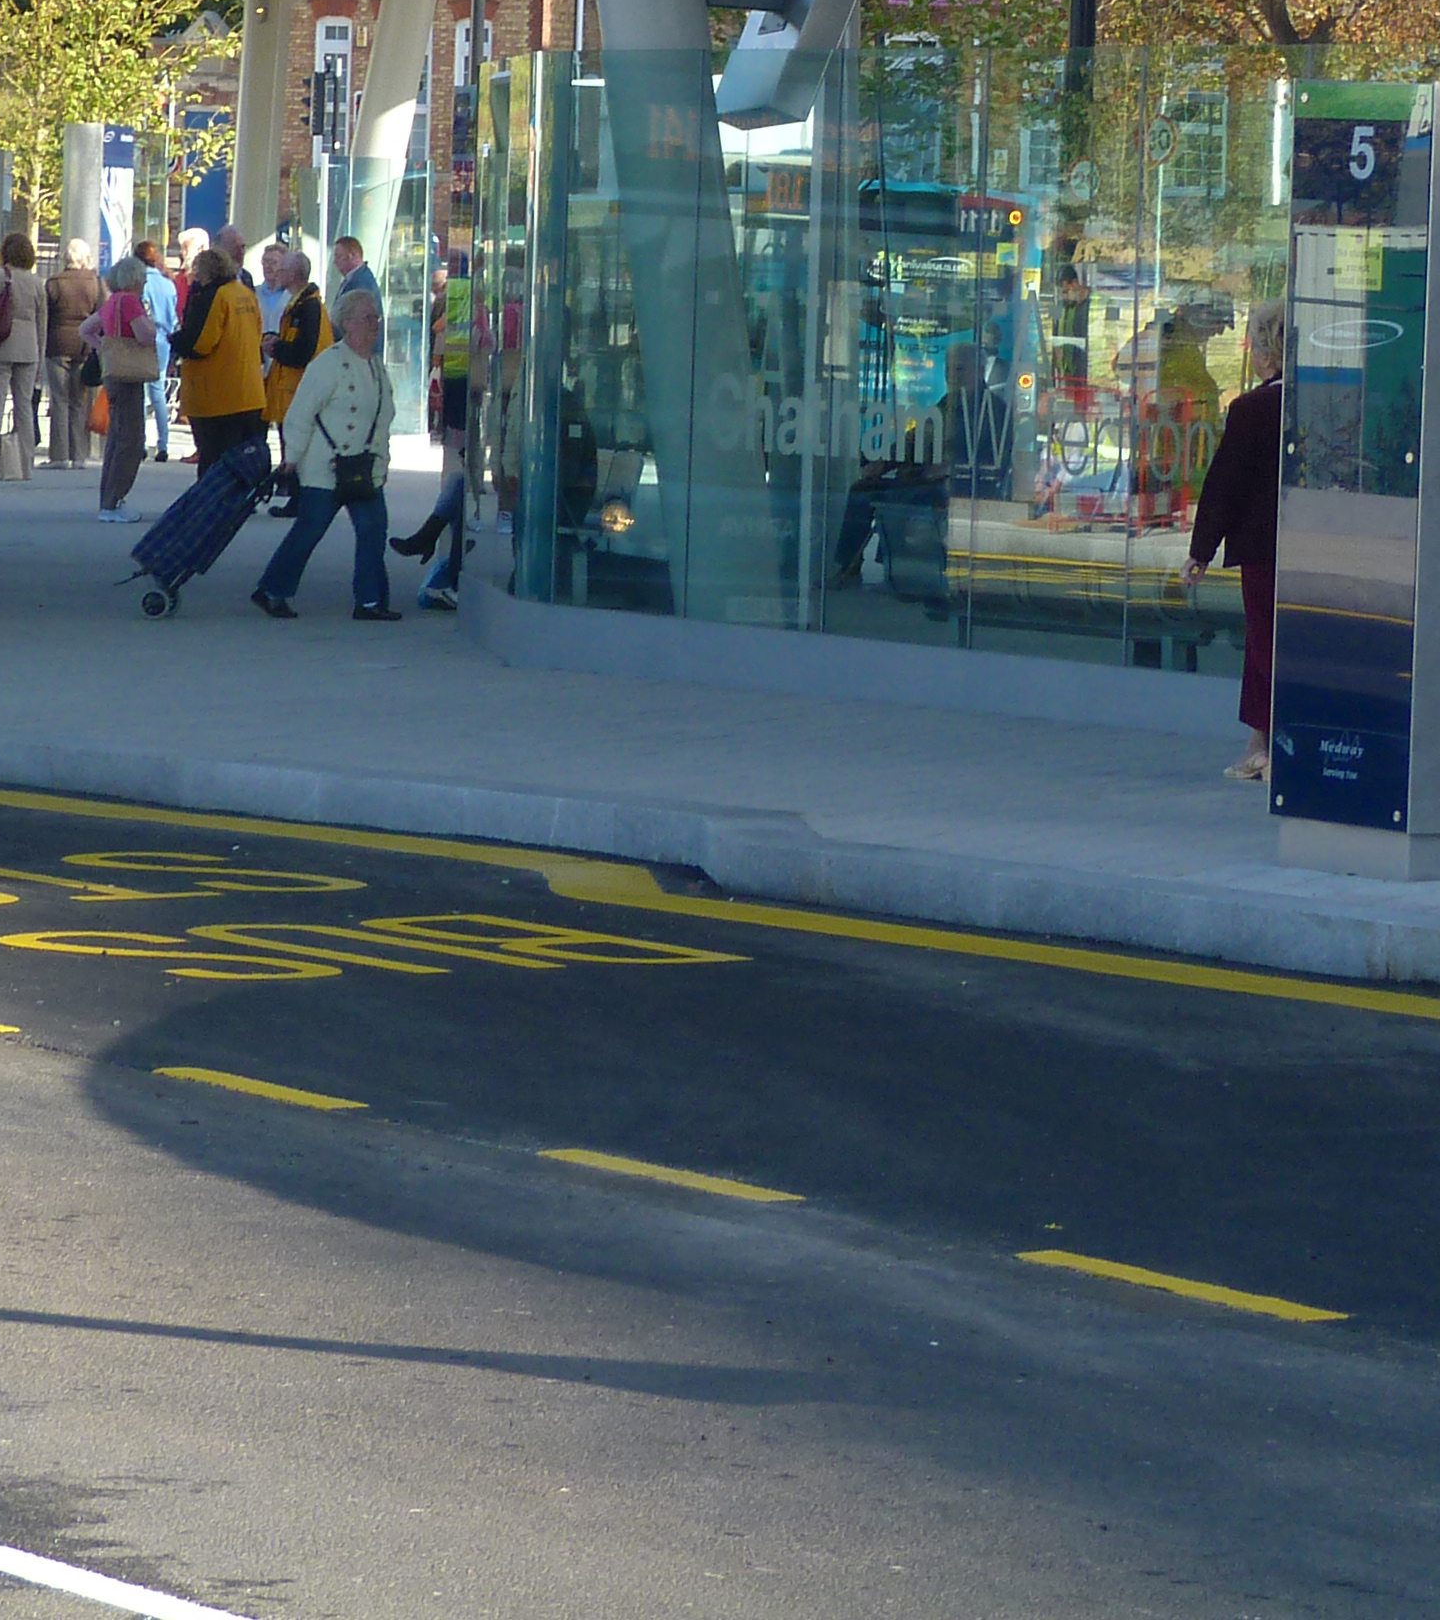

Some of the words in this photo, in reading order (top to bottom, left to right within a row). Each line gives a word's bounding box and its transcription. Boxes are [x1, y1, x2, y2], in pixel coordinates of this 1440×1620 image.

[1348, 125, 1376, 180] 5
[705, 371, 944, 465] Chatham
[1319, 739, 1365, 759] Medway
